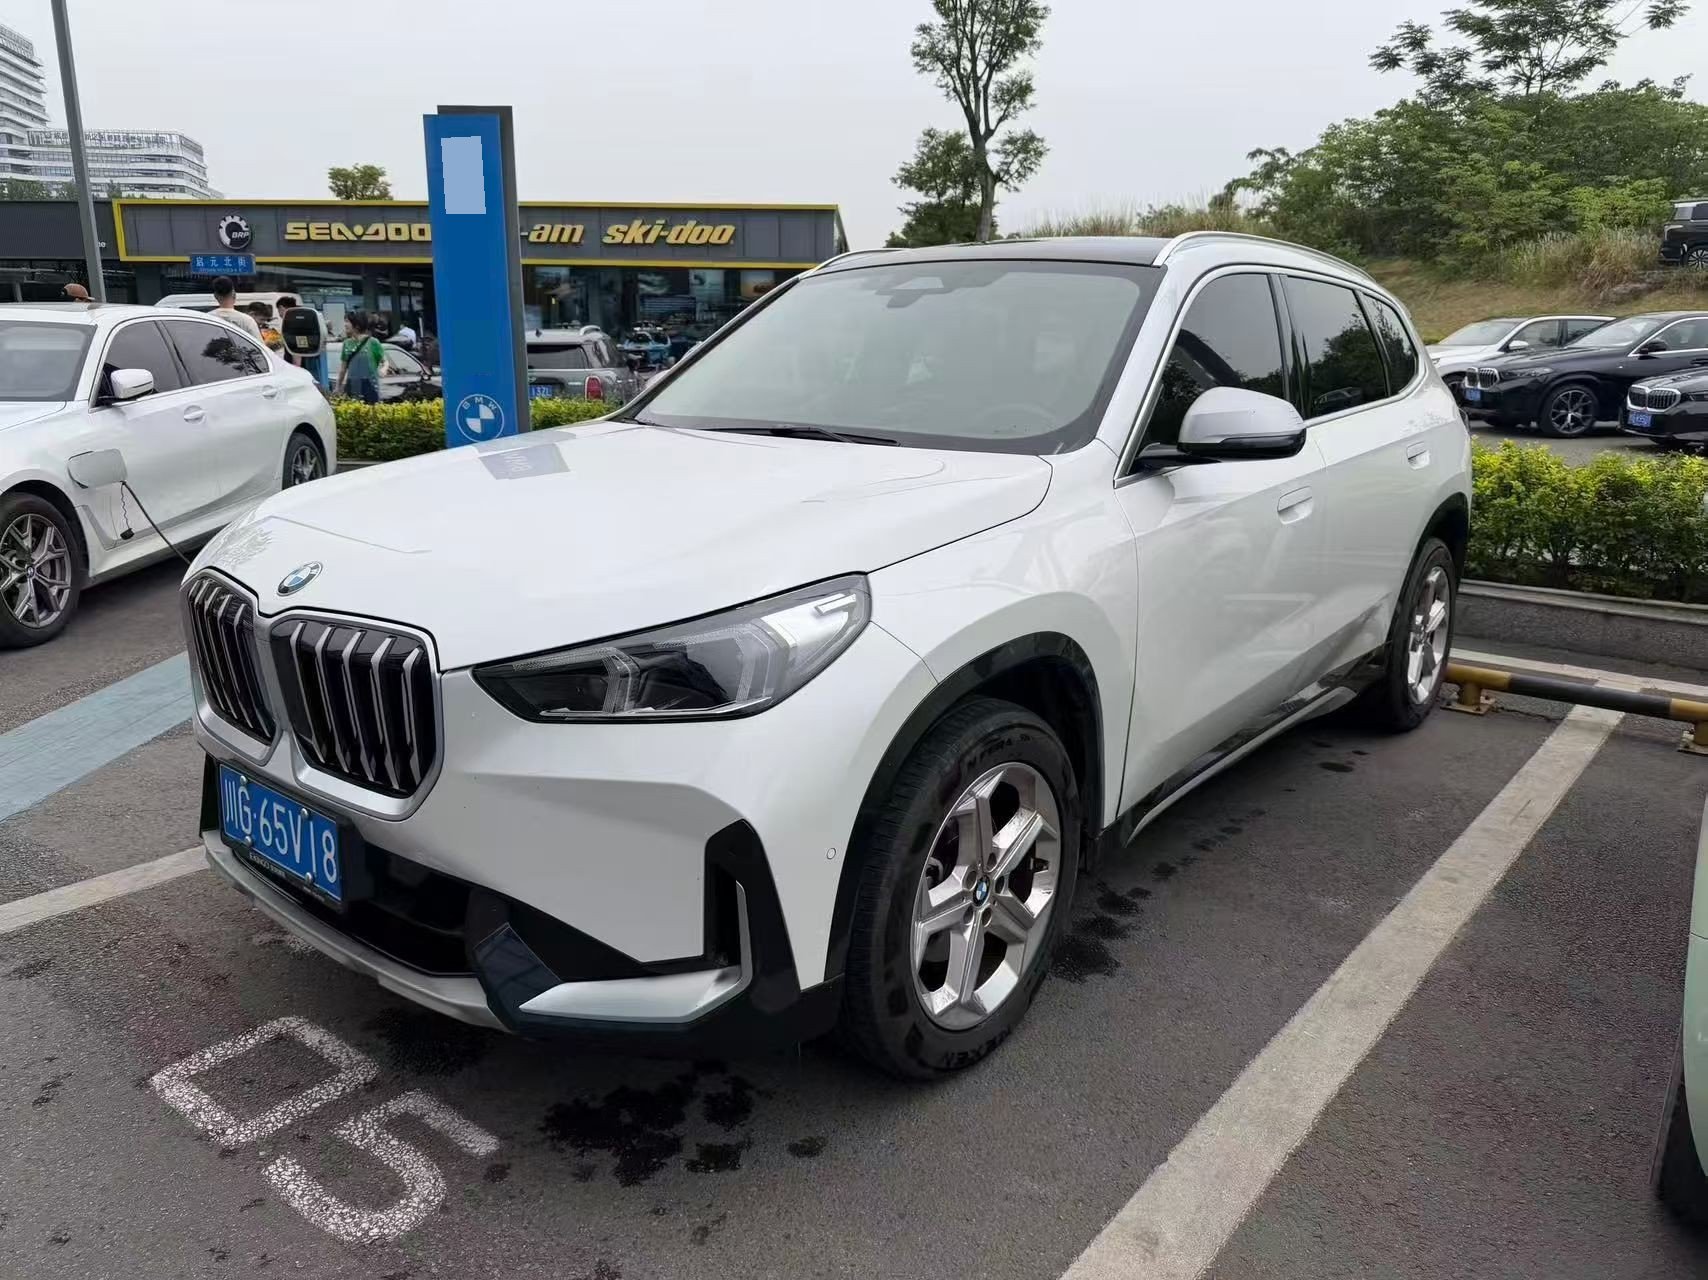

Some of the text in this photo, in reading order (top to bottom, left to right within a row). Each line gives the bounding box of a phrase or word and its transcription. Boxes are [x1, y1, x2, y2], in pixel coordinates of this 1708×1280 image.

[231, 231, 250, 239] BRP
[520, 223, 585, 244] -am
[602, 219, 736, 245] ski-doo
[461, 396, 498, 410] BMW
